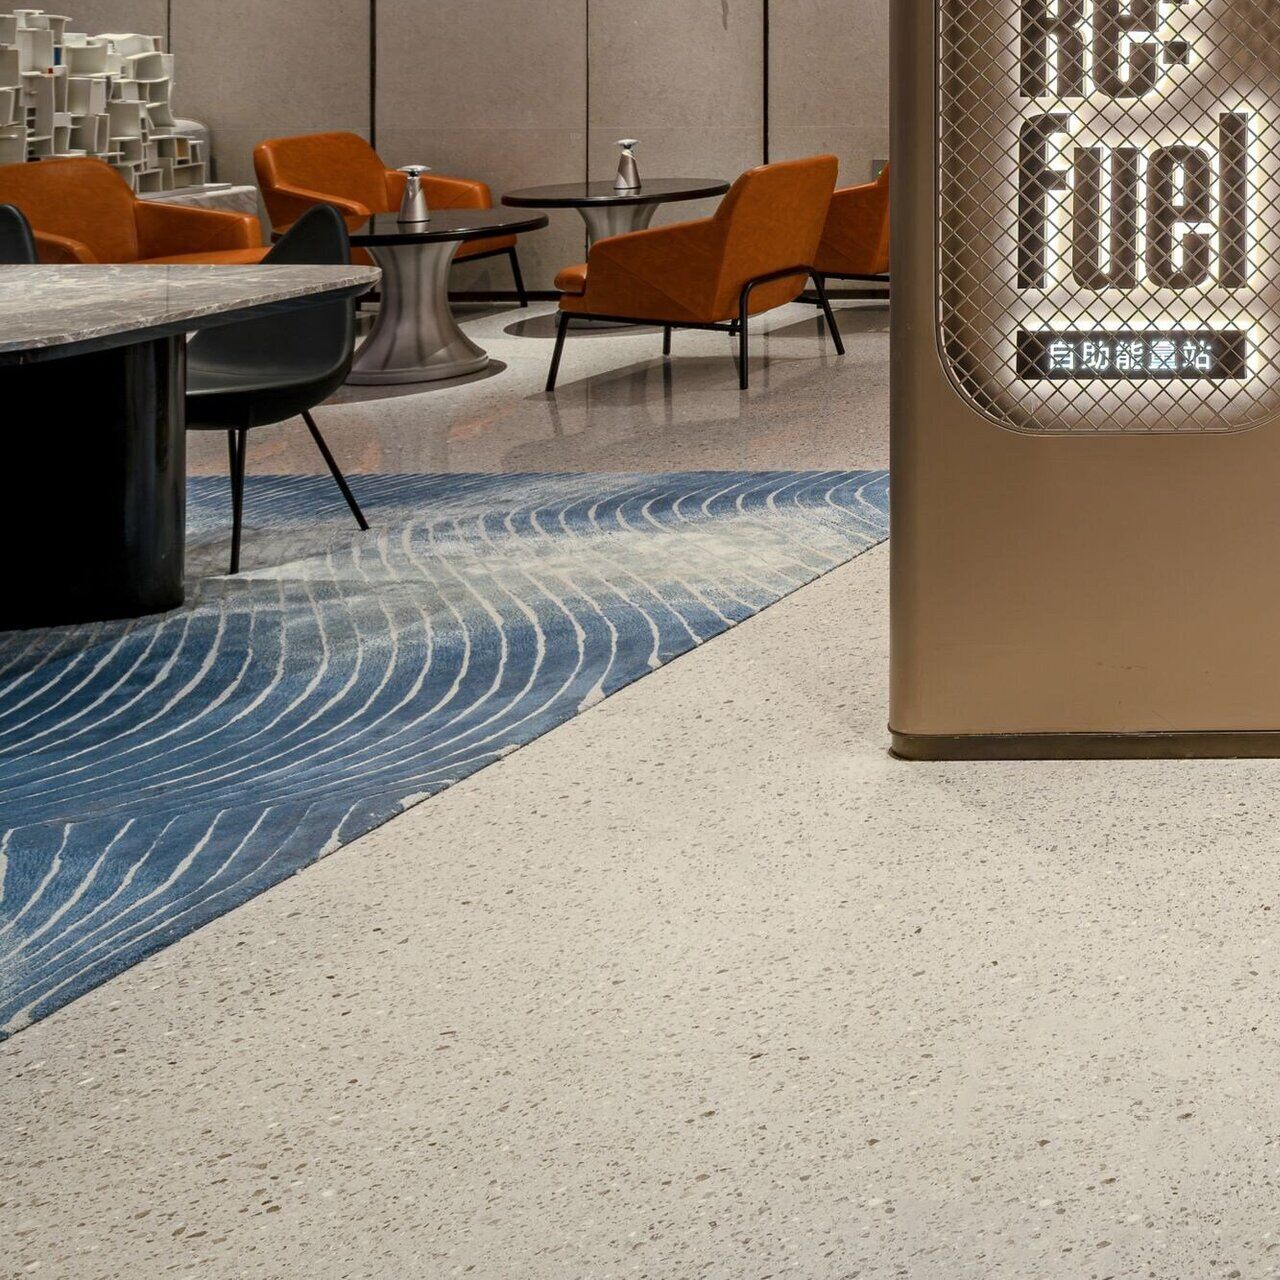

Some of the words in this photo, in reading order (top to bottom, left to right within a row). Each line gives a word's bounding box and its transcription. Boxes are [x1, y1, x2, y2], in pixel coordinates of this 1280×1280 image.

[1048, 340, 1212, 371] 自助能量站
